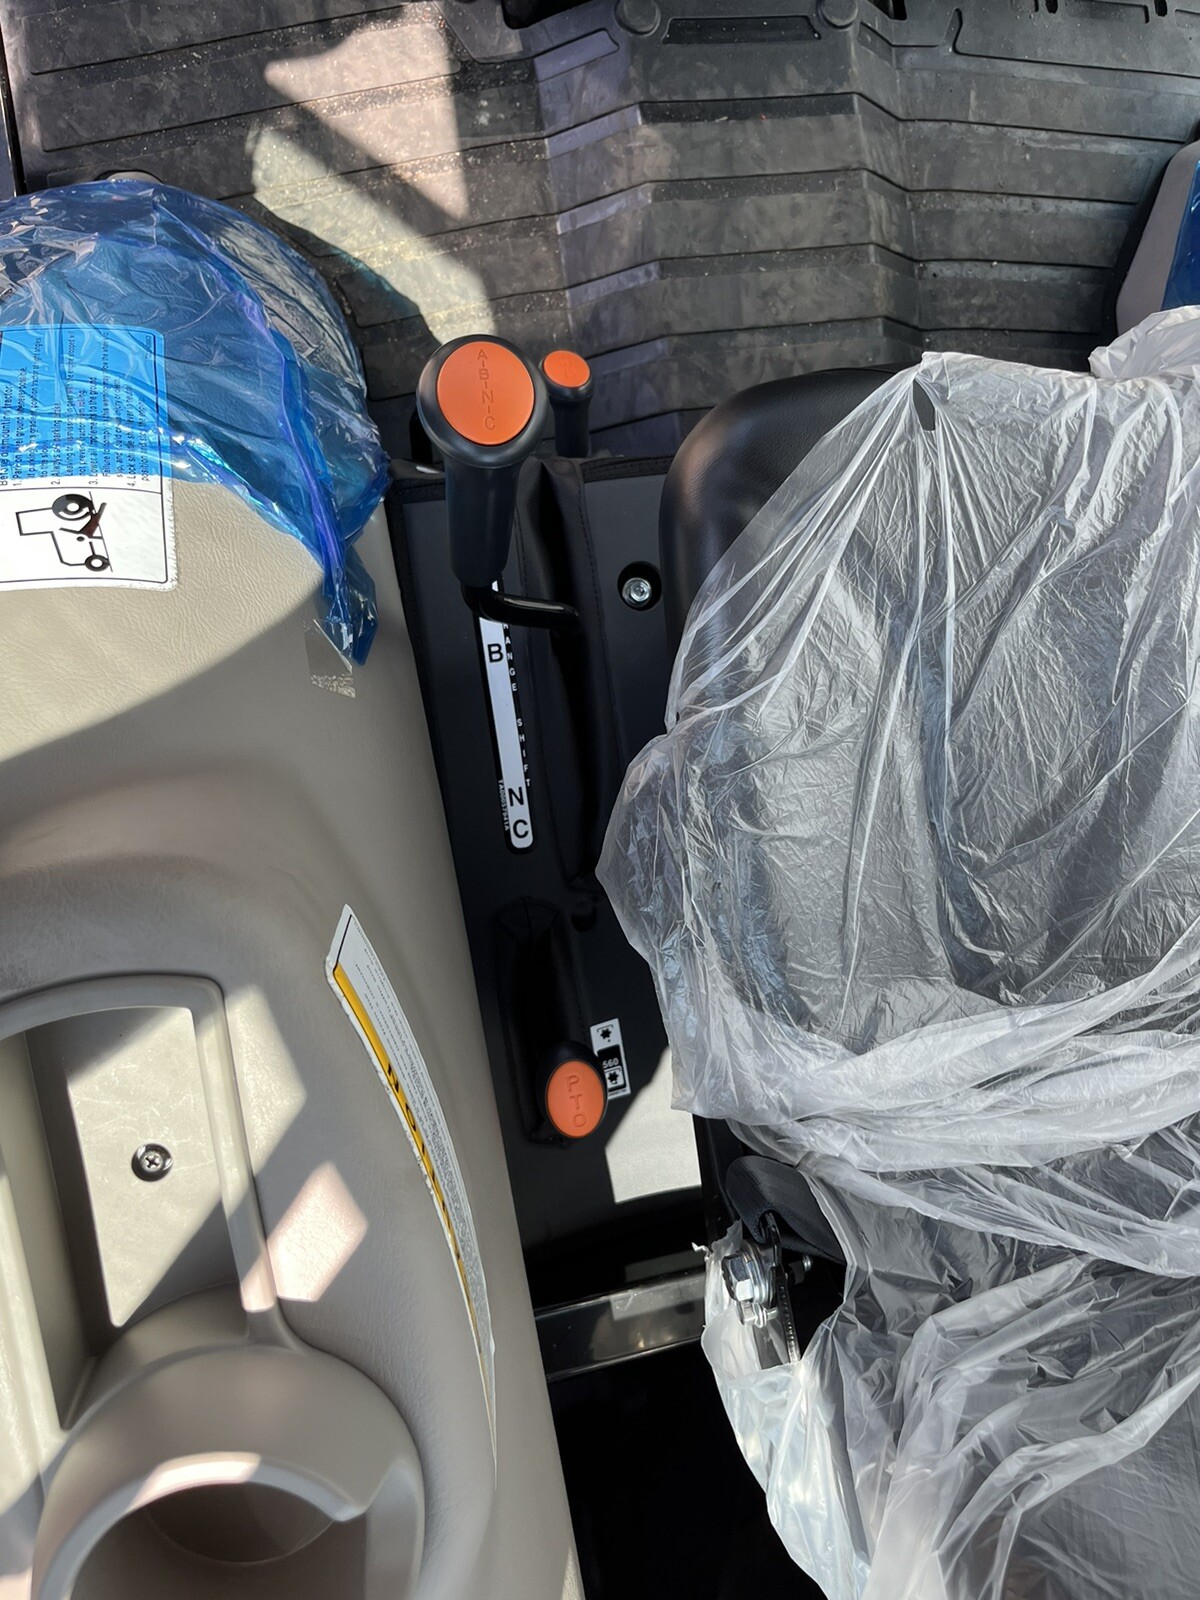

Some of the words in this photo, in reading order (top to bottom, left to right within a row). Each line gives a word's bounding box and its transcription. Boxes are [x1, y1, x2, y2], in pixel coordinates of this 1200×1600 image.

[487, 643, 504, 663] B
[507, 786, 525, 807] N
[512, 819, 529, 839] C
